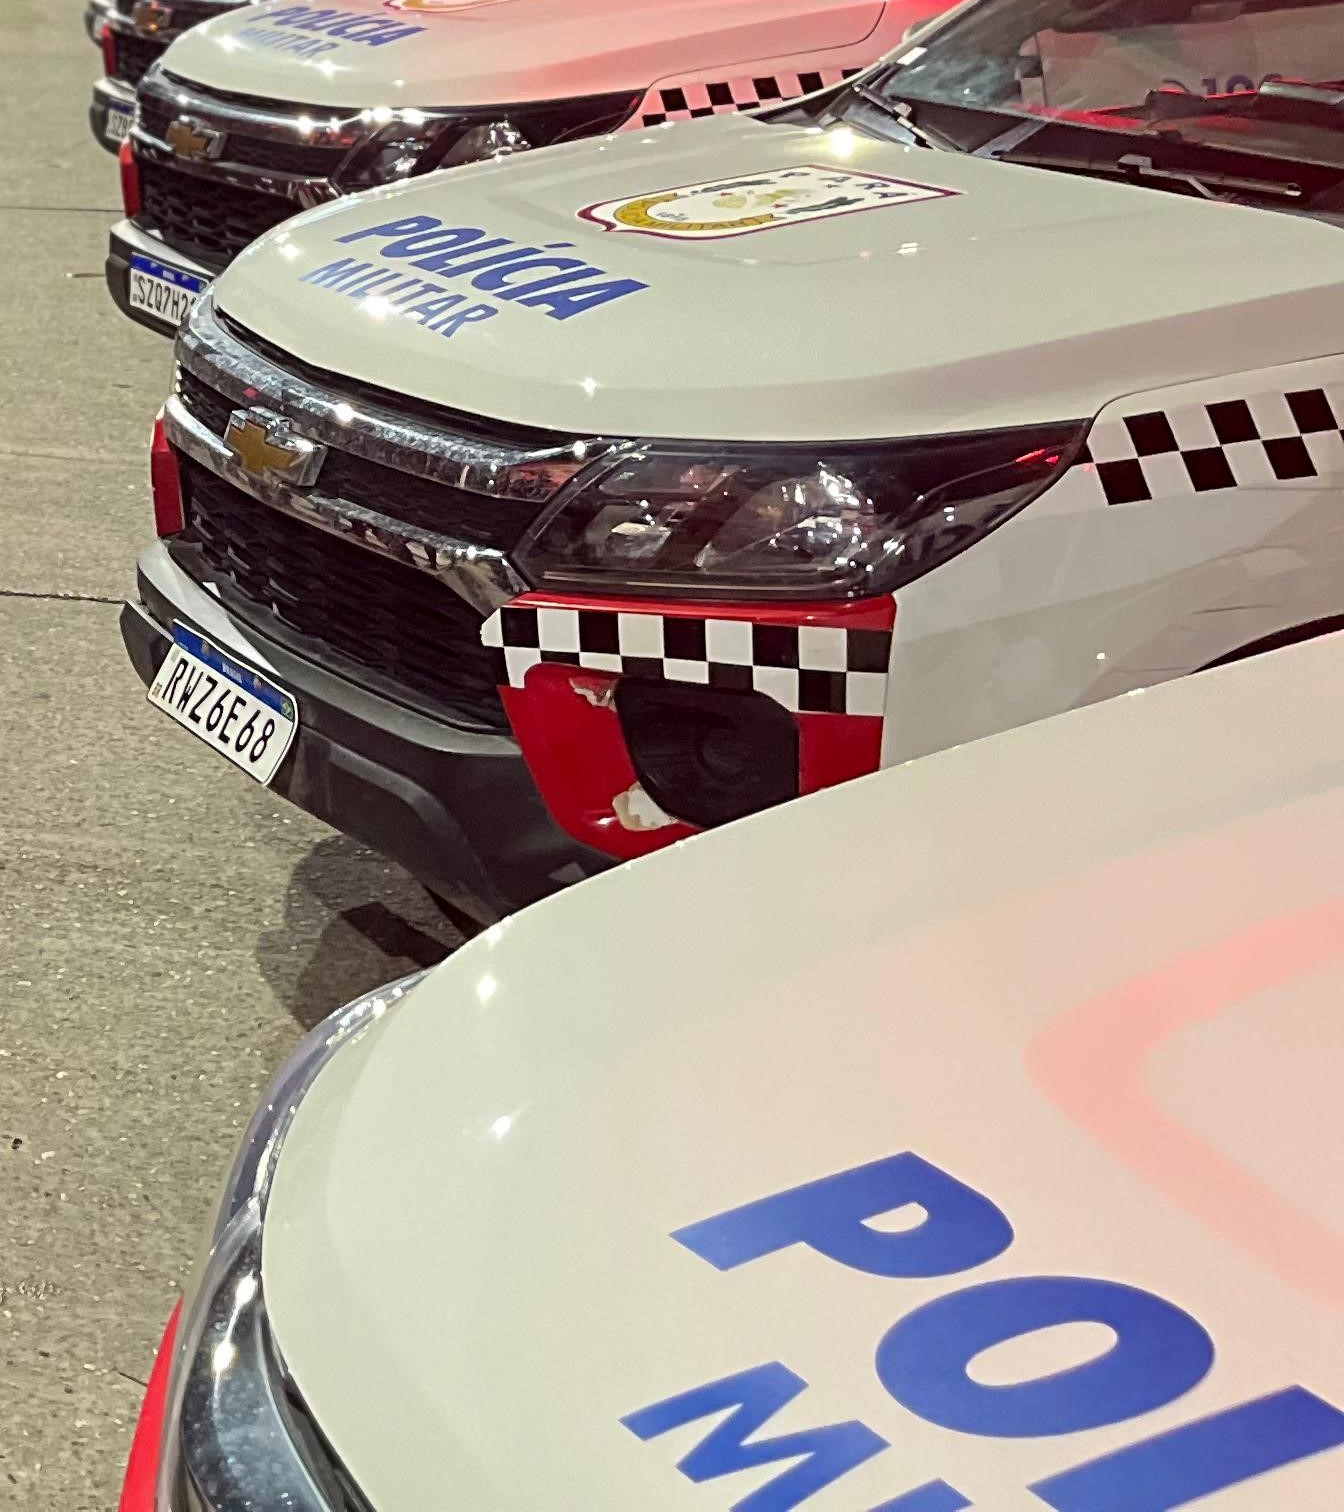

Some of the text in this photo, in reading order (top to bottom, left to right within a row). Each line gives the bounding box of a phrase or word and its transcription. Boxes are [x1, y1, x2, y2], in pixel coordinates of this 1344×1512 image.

[246, 6, 428, 47] POLÍCIA
[298, 257, 499, 339] MILITAR
[334, 215, 651, 321] POLÍCIA
[162, 657, 275, 763] RWZ6E68
